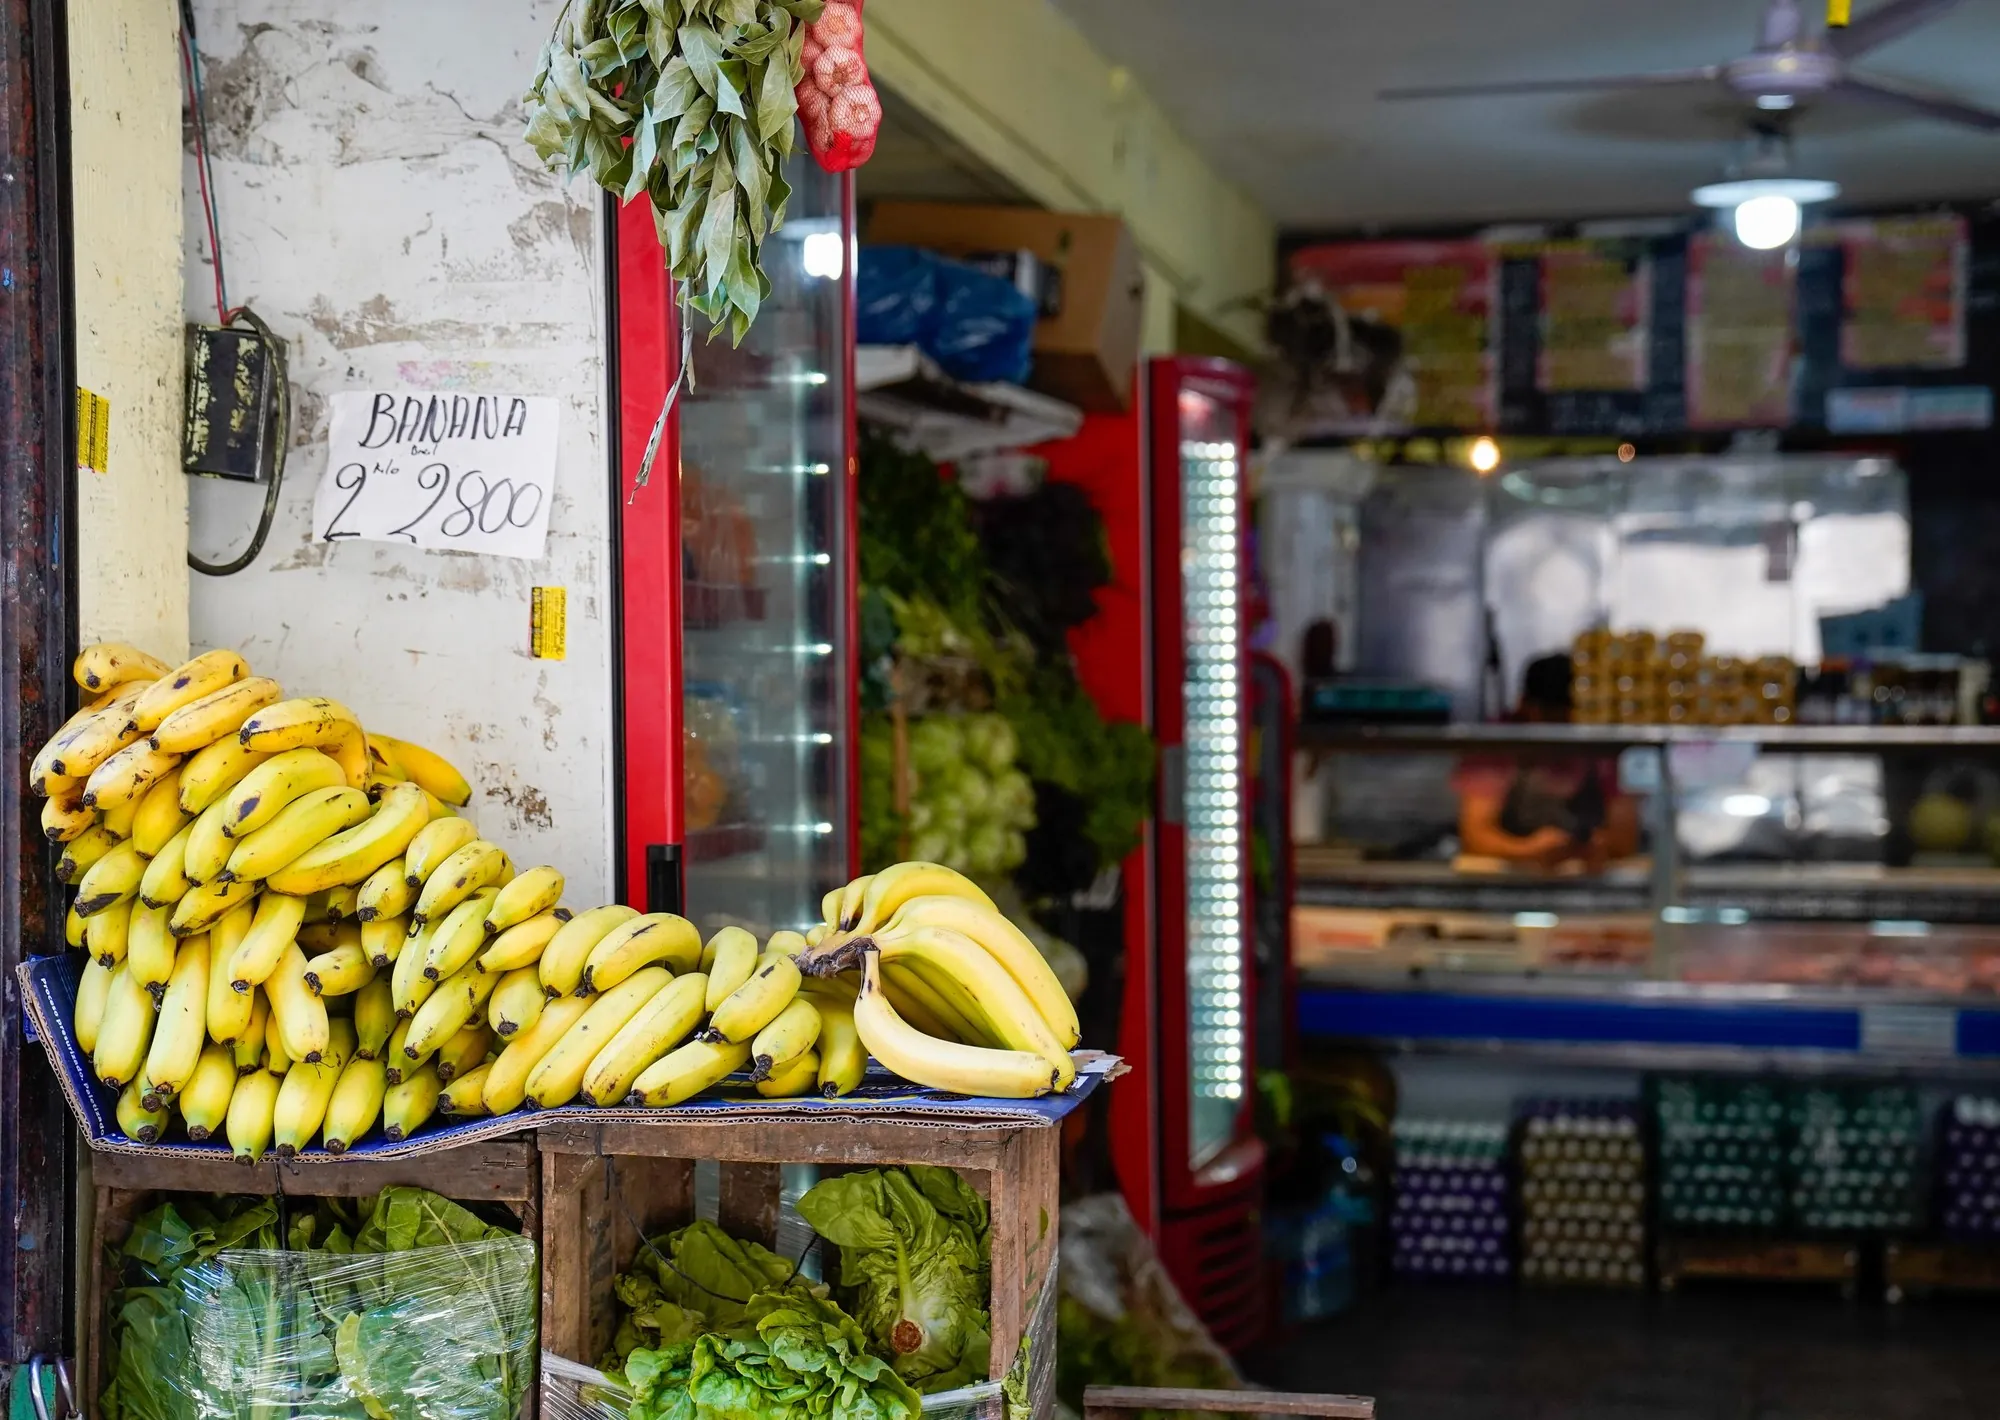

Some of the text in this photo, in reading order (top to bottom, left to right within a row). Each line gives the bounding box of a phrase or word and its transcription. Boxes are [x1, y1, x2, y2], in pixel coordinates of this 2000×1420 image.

[358, 393, 527, 449] BANANA
[323, 462, 367, 542] 2
[387, 462, 543, 544] 2800
[41, 977, 59, 1017] Proceso
[83, 1082, 106, 1136] Paletizado
